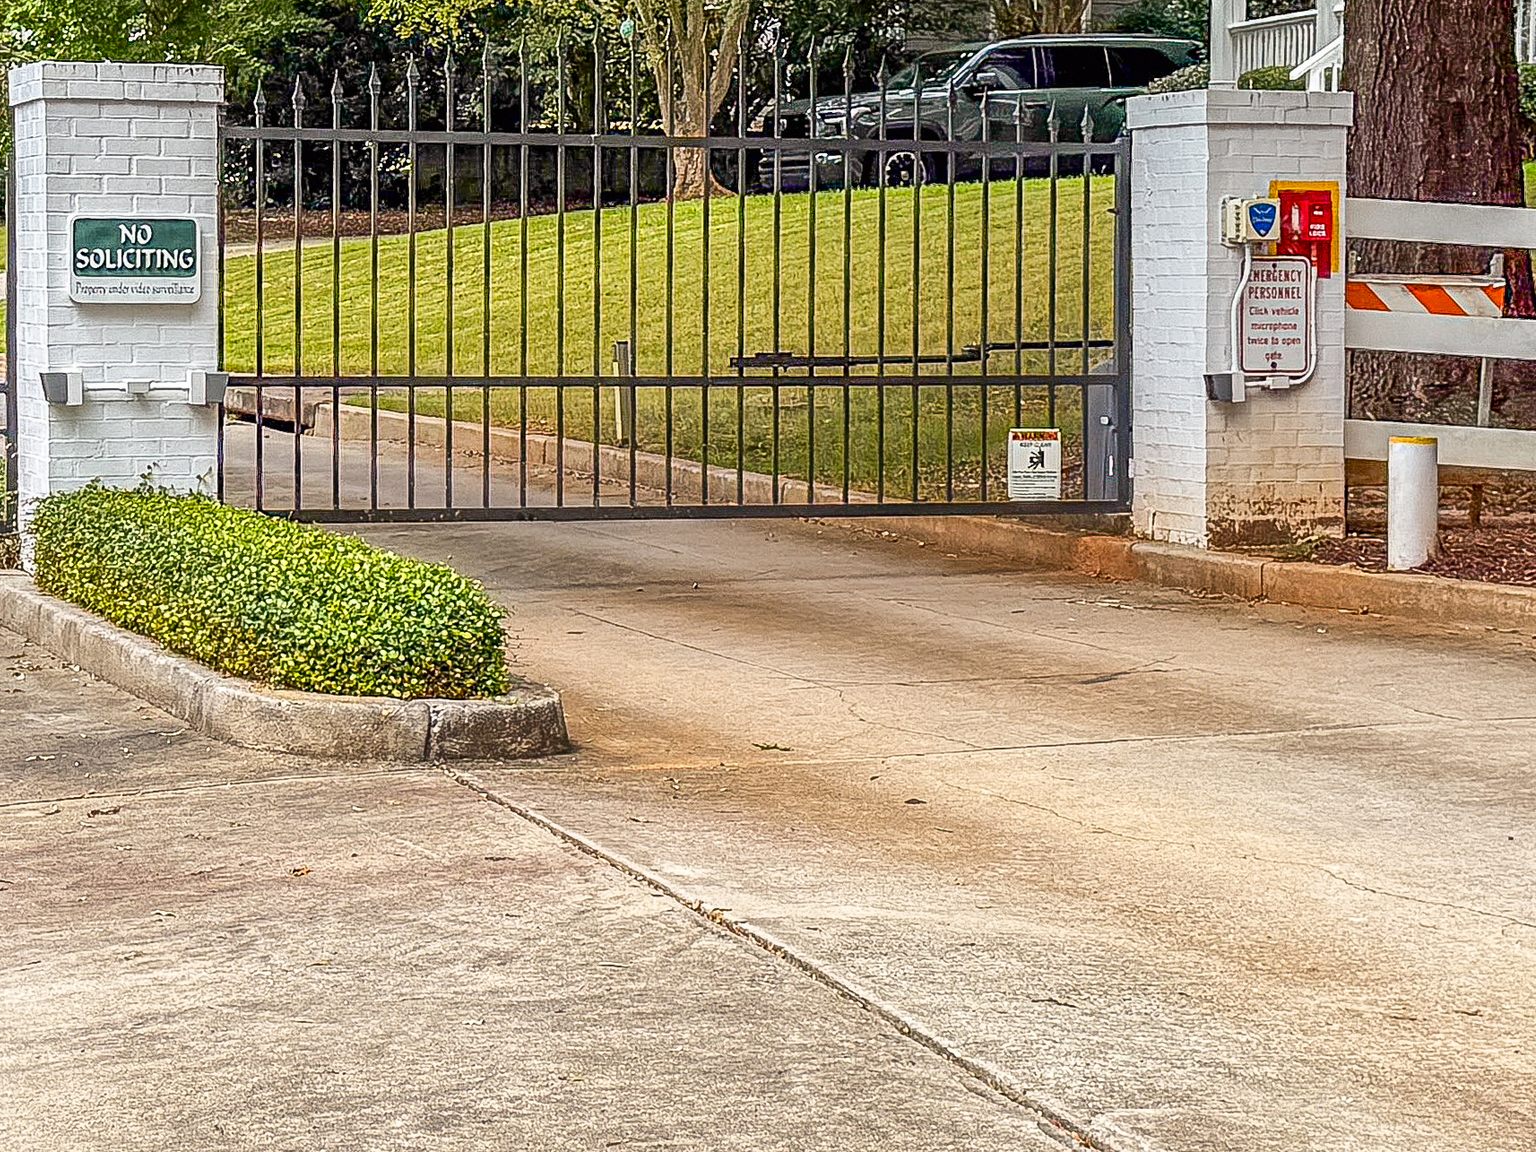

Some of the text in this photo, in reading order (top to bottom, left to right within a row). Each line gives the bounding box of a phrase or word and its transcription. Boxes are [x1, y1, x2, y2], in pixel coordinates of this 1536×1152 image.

[118, 224, 153, 245] NO
[76, 248, 194, 269] SOLICITING
[1248, 270, 1302, 282] EMERGENCY
[1248, 286, 1302, 299] PERSONNEL
